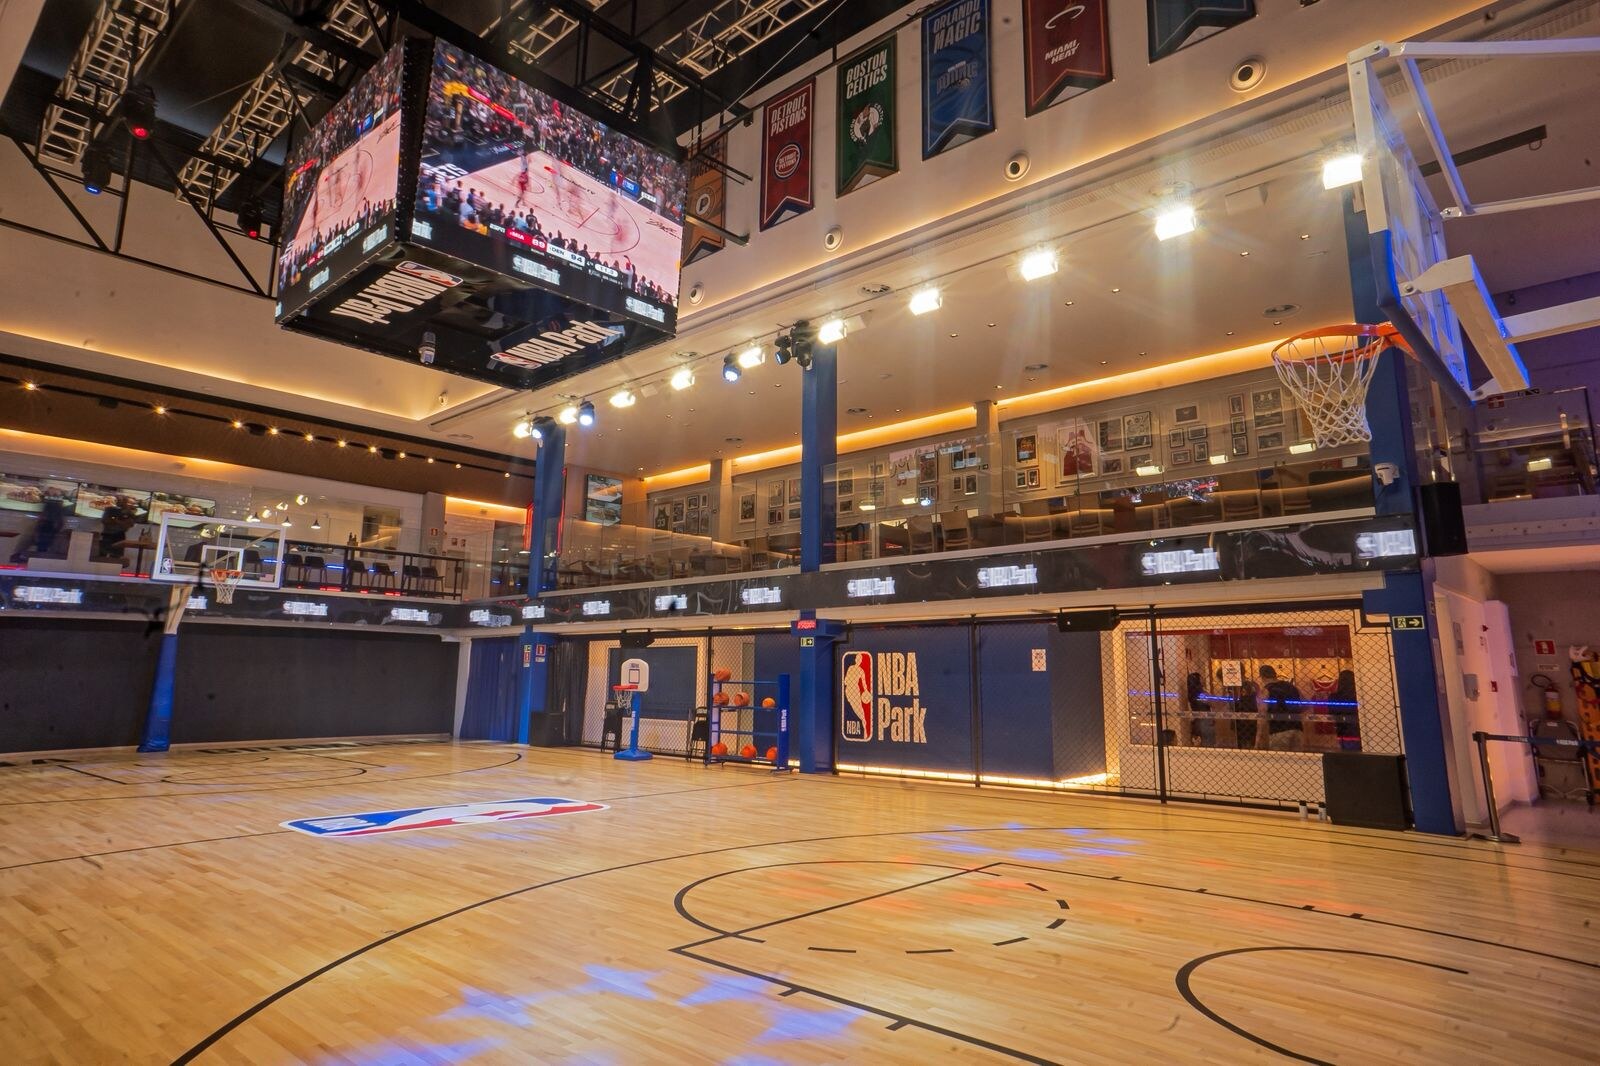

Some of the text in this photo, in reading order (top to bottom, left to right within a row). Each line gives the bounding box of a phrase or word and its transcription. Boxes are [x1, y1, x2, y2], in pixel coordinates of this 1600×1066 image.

[933, 0, 981, 34] ORLANDO
[934, 11, 981, 55] MAGIC
[846, 49, 888, 85] BOSTON
[1045, 39, 1076, 61] MIAMI
[1051, 43, 1080, 65] HEAT
[846, 64, 888, 100] CELTICS
[770, 106, 807, 137] PISTONS
[771, 92, 807, 124] DETROIT
[362, 270, 449, 306] NBA
[504, 337, 578, 364] NBA
[877, 652, 919, 696] NBA
[846, 720, 861, 735] NBA
[877, 697, 928, 744] Park
